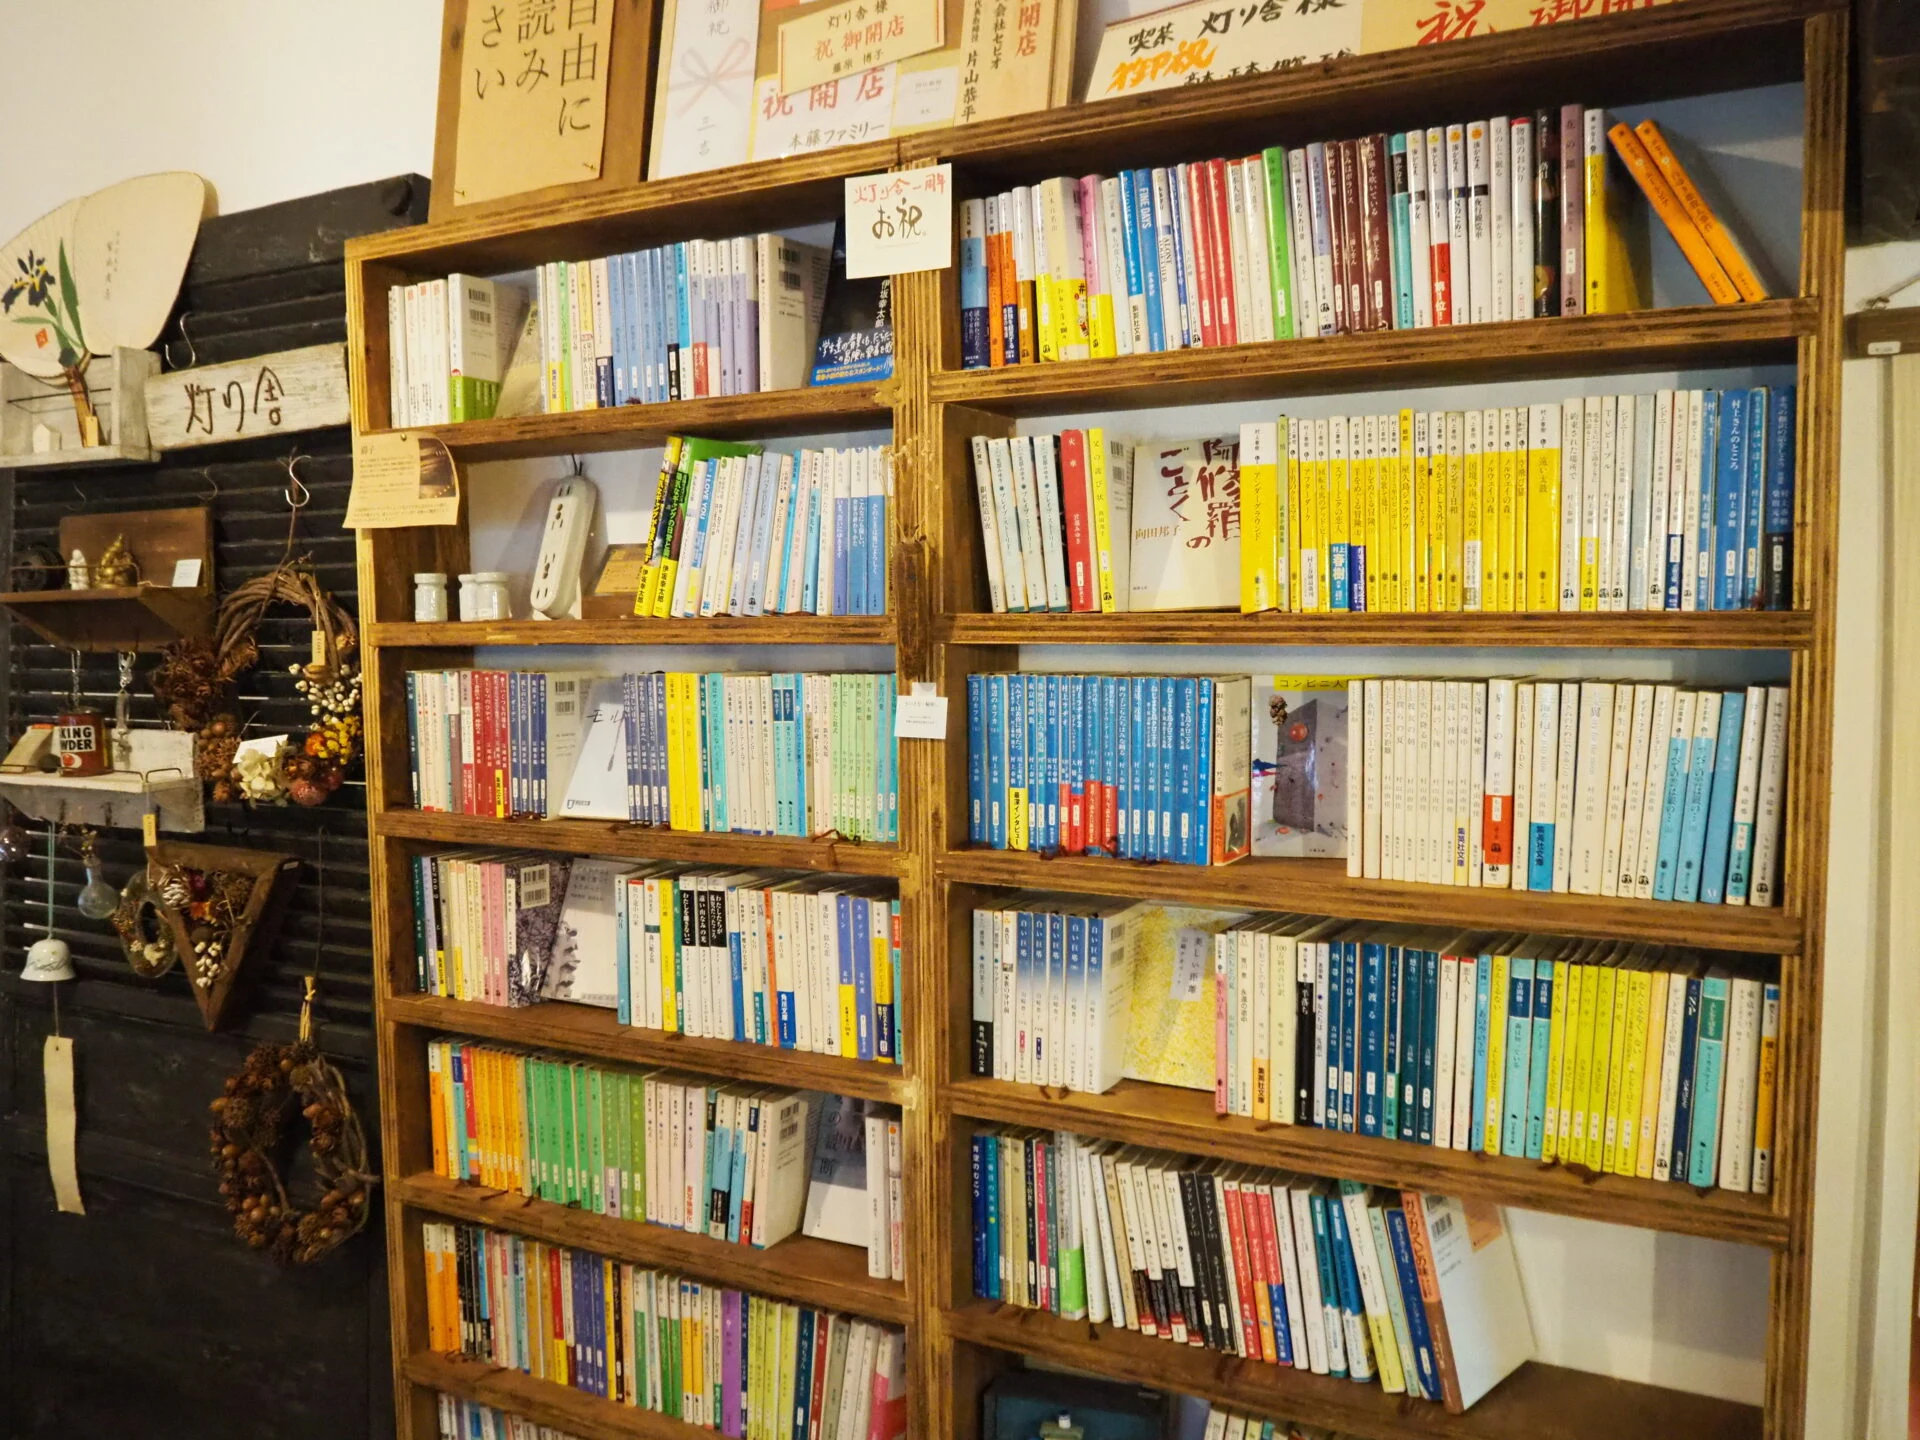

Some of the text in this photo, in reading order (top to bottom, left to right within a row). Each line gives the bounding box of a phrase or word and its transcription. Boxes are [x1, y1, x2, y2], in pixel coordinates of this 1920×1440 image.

[475, 5, 506, 100] さい
[815, 15, 905, 61] 祝 御開店
[1128, 22, 1175, 56] 喫茶
[561, 0, 598, 137] 自由に
[1139, 187, 1152, 229] FINE DAYS
[186, 366, 286, 436] 灯り舎
[1730, 399, 1741, 471] 村上さんのところ
[1160, 447, 1190, 522] ごとく
[1134, 525, 1181, 541] 向田邦子
[990, 682, 998, 725] 海辺のカフカ
[1280, 679, 1348, 689] コンビニ人
[856, 904, 864, 938] スキップ
[1020, 919, 1028, 958] 白い巨塔
[1035, 920, 1043, 959] 白い巨塔
[1052, 921, 1060, 960] 白い巨塔
[1071, 923, 1080, 963] 白い巨塔
[1090, 925, 1098, 965] 白い巨塔
[1367, 957, 1378, 1019] 橋を渡る
